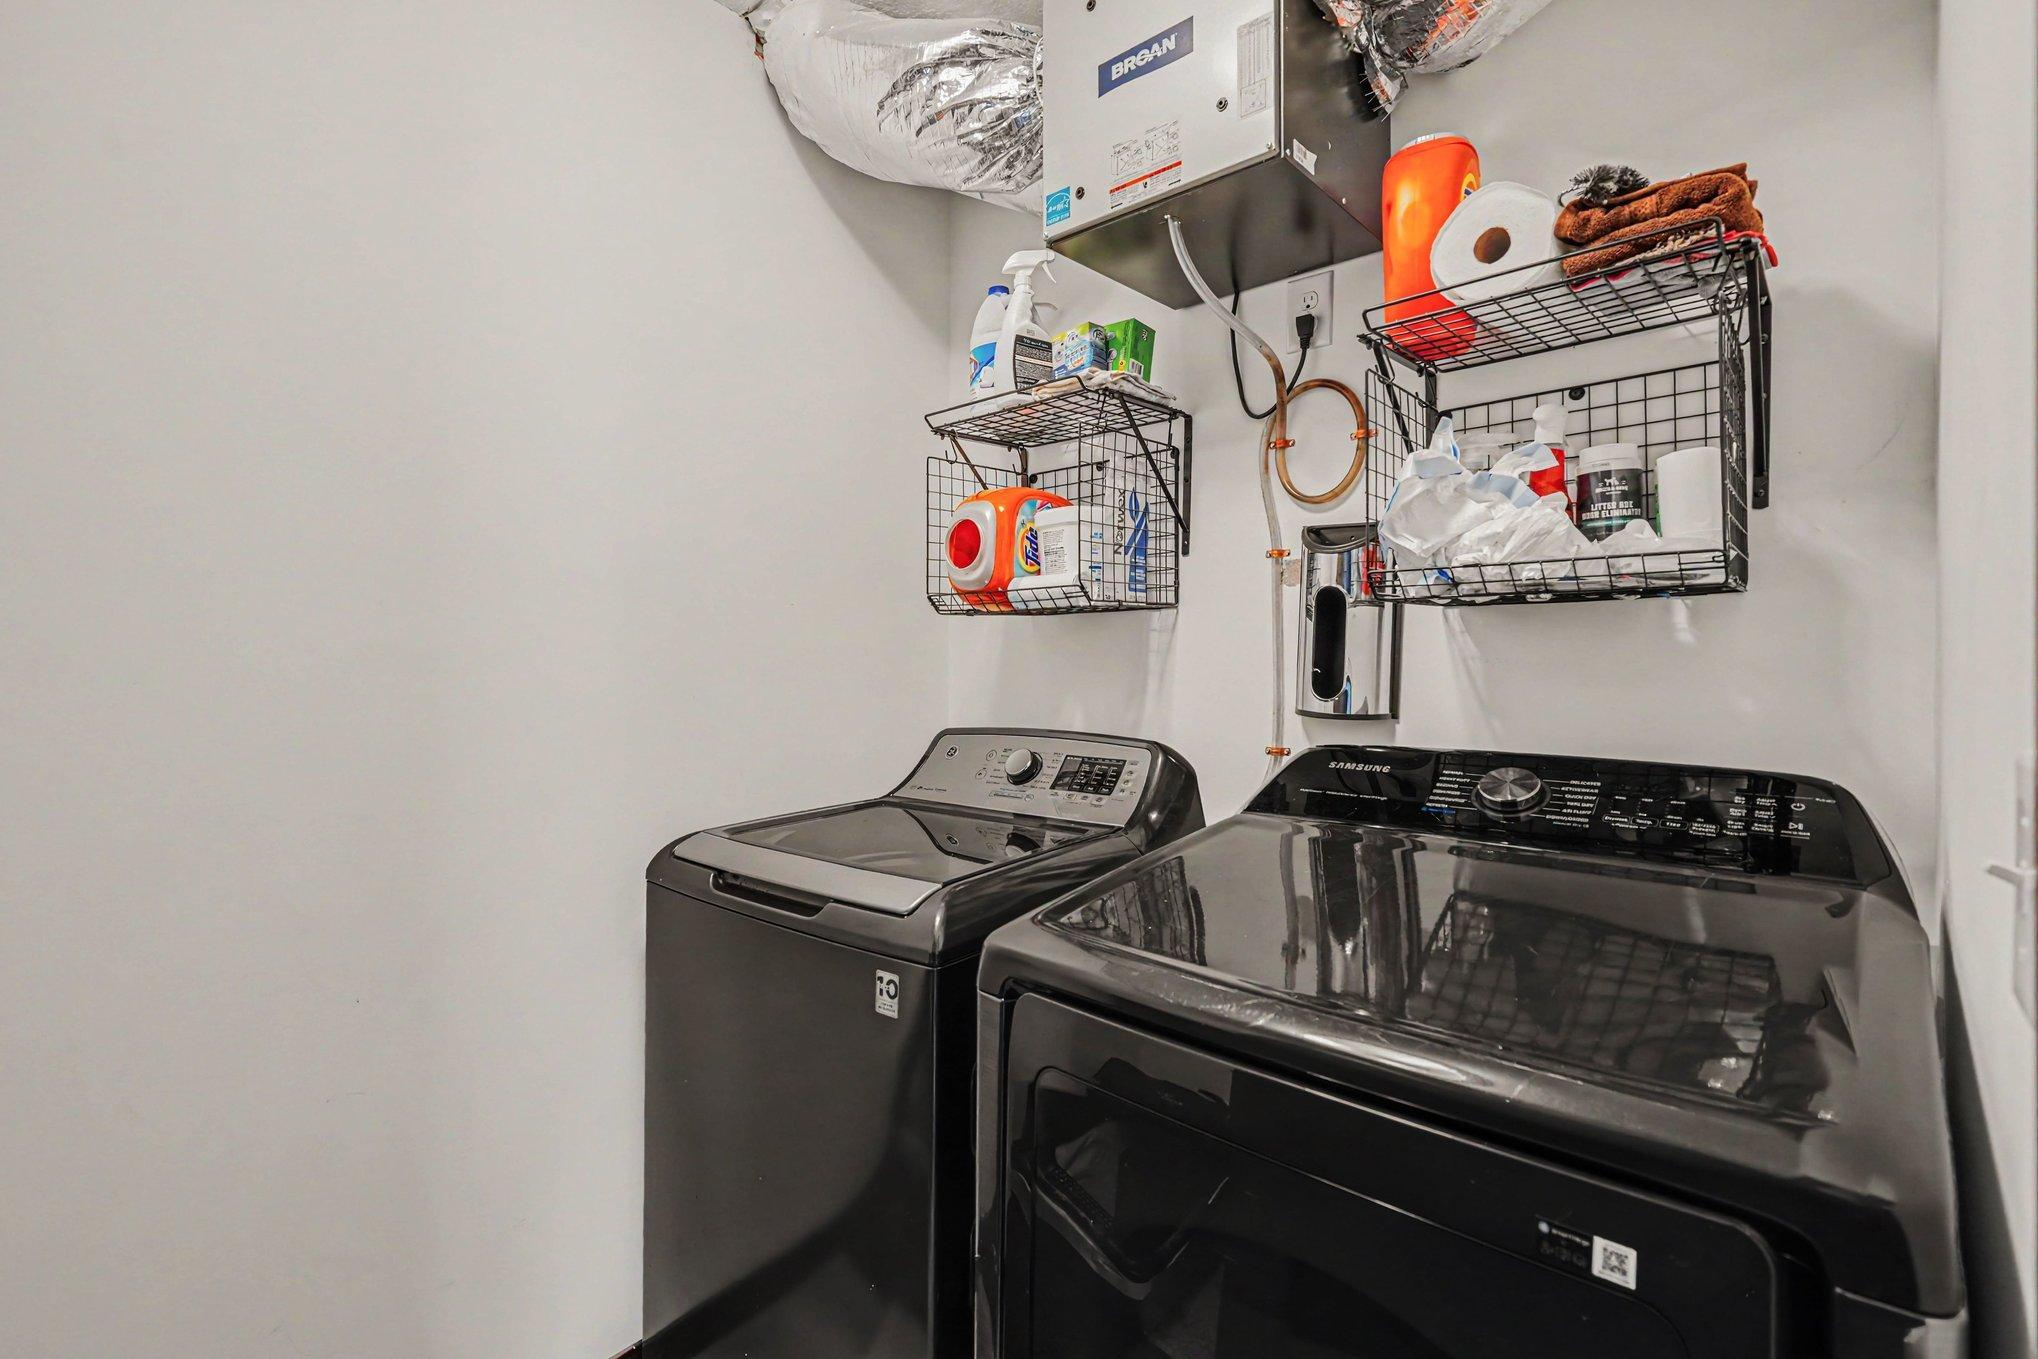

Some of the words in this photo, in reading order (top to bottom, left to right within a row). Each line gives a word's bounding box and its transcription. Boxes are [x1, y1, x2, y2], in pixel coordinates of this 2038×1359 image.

[1111, 33, 1176, 80] BROAN
[1591, 502, 1617, 511] LITTER
[1024, 526, 1041, 567] Tide
[1328, 761, 1391, 773] SAMSUNG
